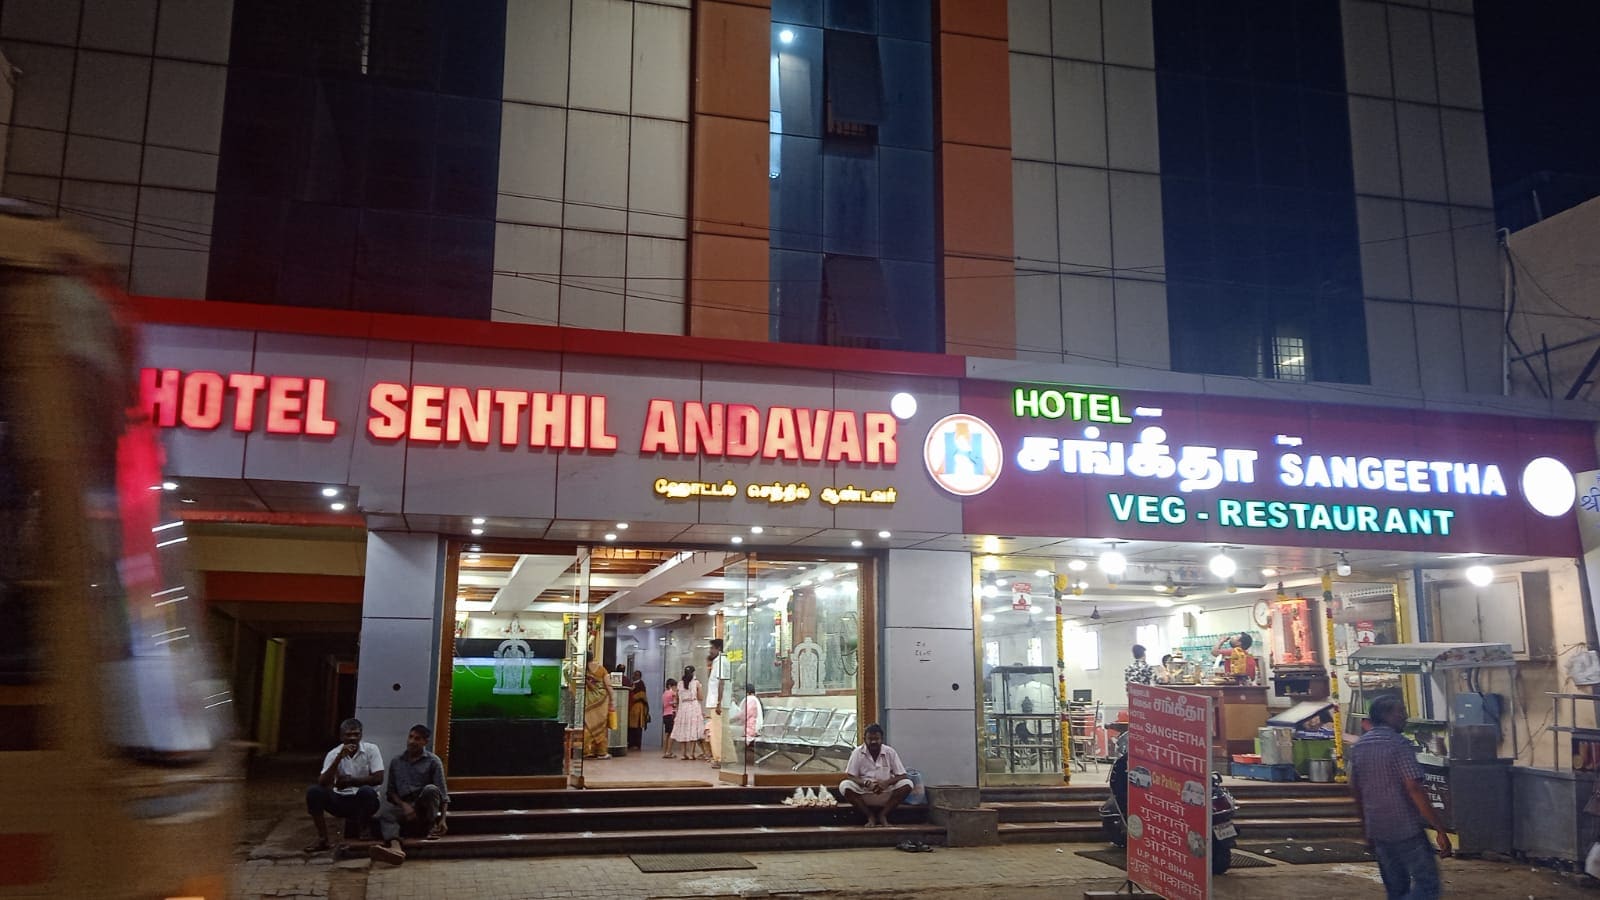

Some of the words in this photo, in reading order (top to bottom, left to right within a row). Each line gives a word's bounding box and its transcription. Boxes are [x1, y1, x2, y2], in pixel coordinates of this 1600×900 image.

[141, 368, 337, 436] HOTEL
[368, 382, 618, 451] SENTHIL
[640, 397, 897, 465] ANDAVAR
[1014, 388, 1132, 424] HOTEL
[1017, 426, 1258, 492] சங்கீதா
[1280, 453, 1507, 496] SANGEETHA
[1109, 493, 1187, 524] VEG
[1219, 499, 1455, 536] RESTAURANT
[1145, 722, 1207, 749] SANGEETHA
[1145, 740, 1206, 774] संगीता
[1428, 792, 1442, 802] TEA
[1147, 823, 1182, 846] मराठी
